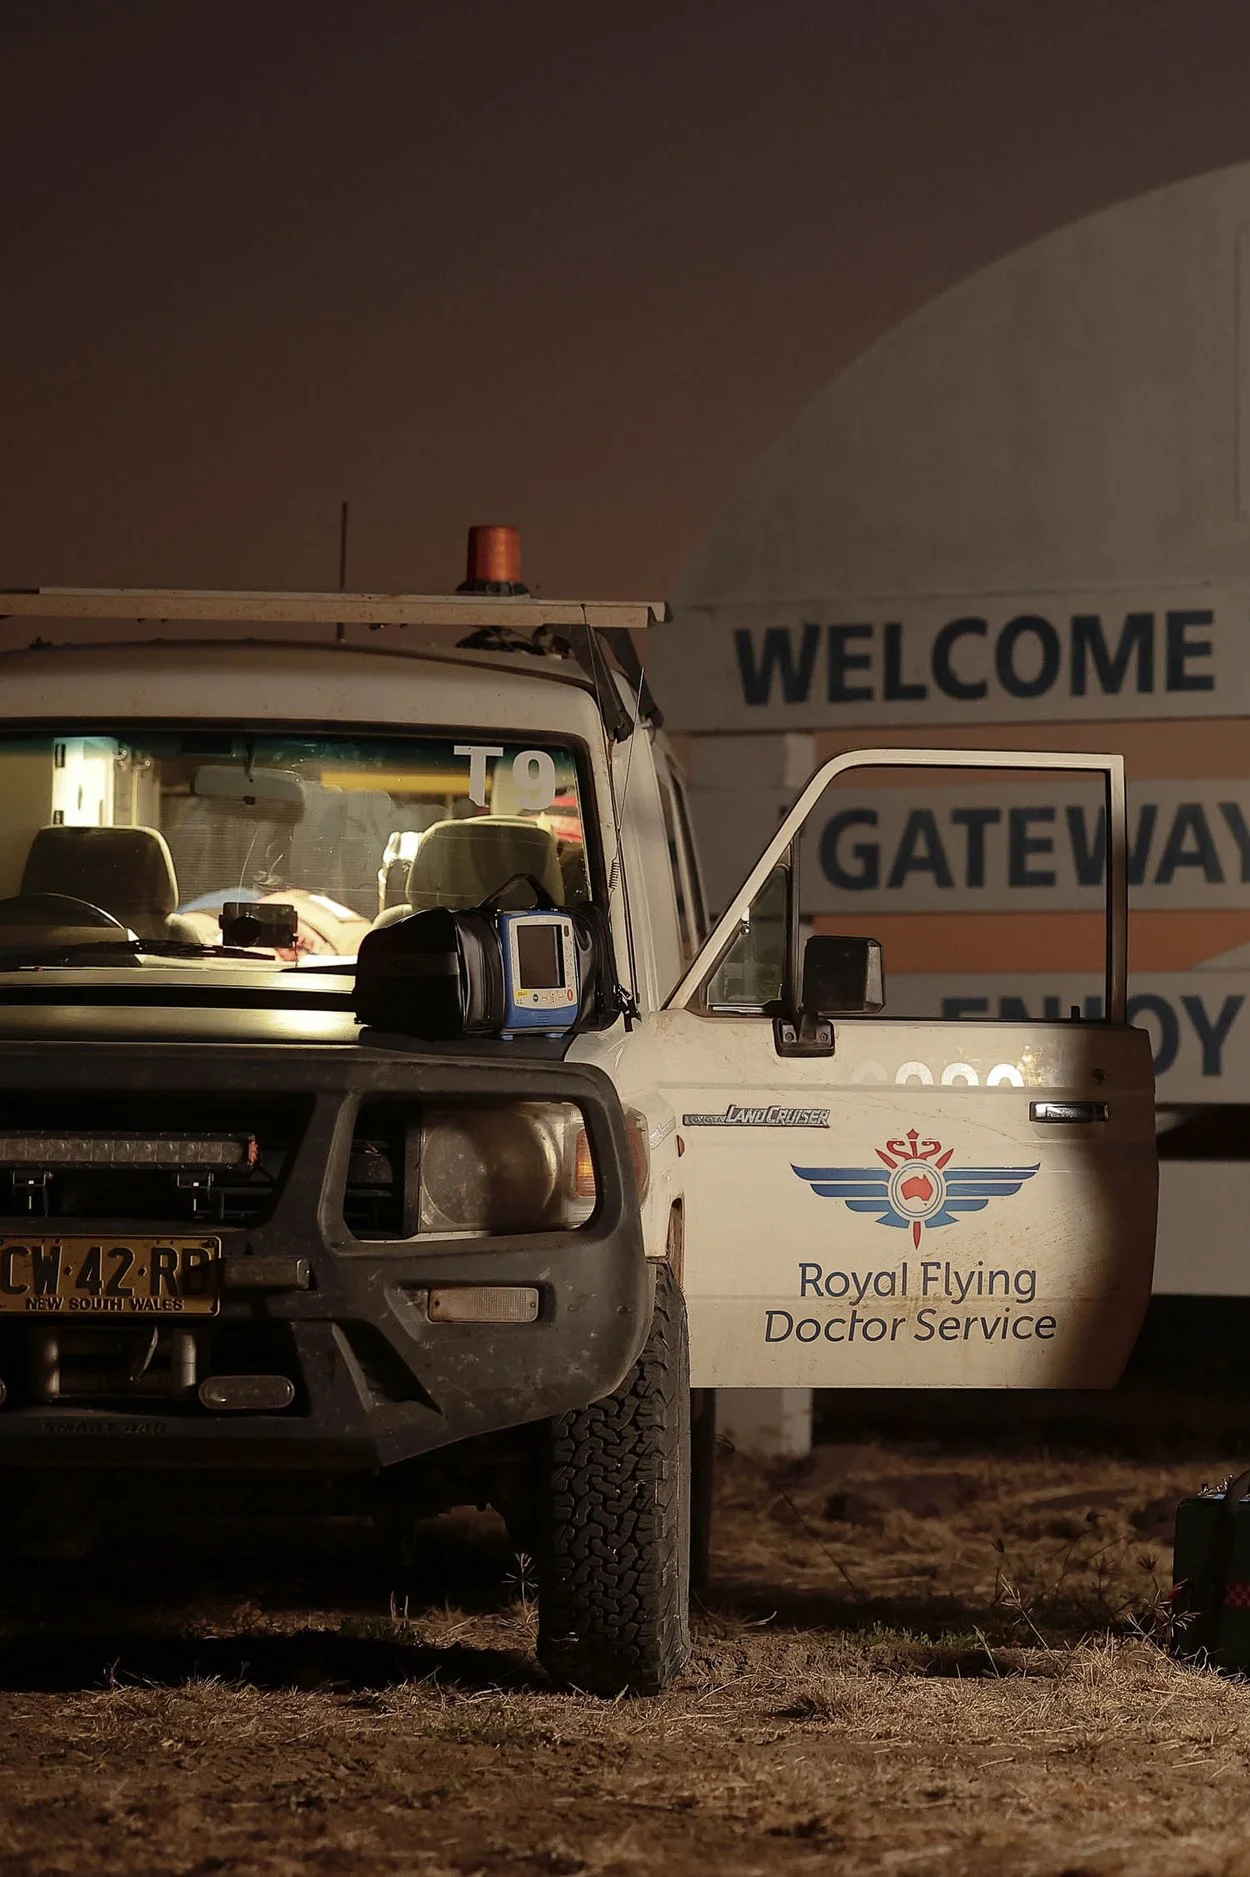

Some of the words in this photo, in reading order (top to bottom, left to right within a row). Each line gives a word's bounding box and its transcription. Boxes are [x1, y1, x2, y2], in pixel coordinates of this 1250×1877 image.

[734, 610, 1216, 706] WELCOME
[453, 745, 556, 810] T9
[26, 1297, 64, 1311] NEW
[69, 1297, 125, 1311] SOUTH
[130, 1298, 185, 1311] WALES
[799, 1262, 907, 1306] Royal
[920, 1261, 1037, 1304] Flying
[764, 1309, 906, 1343] Doctor
[914, 1308, 1057, 1341] Service
